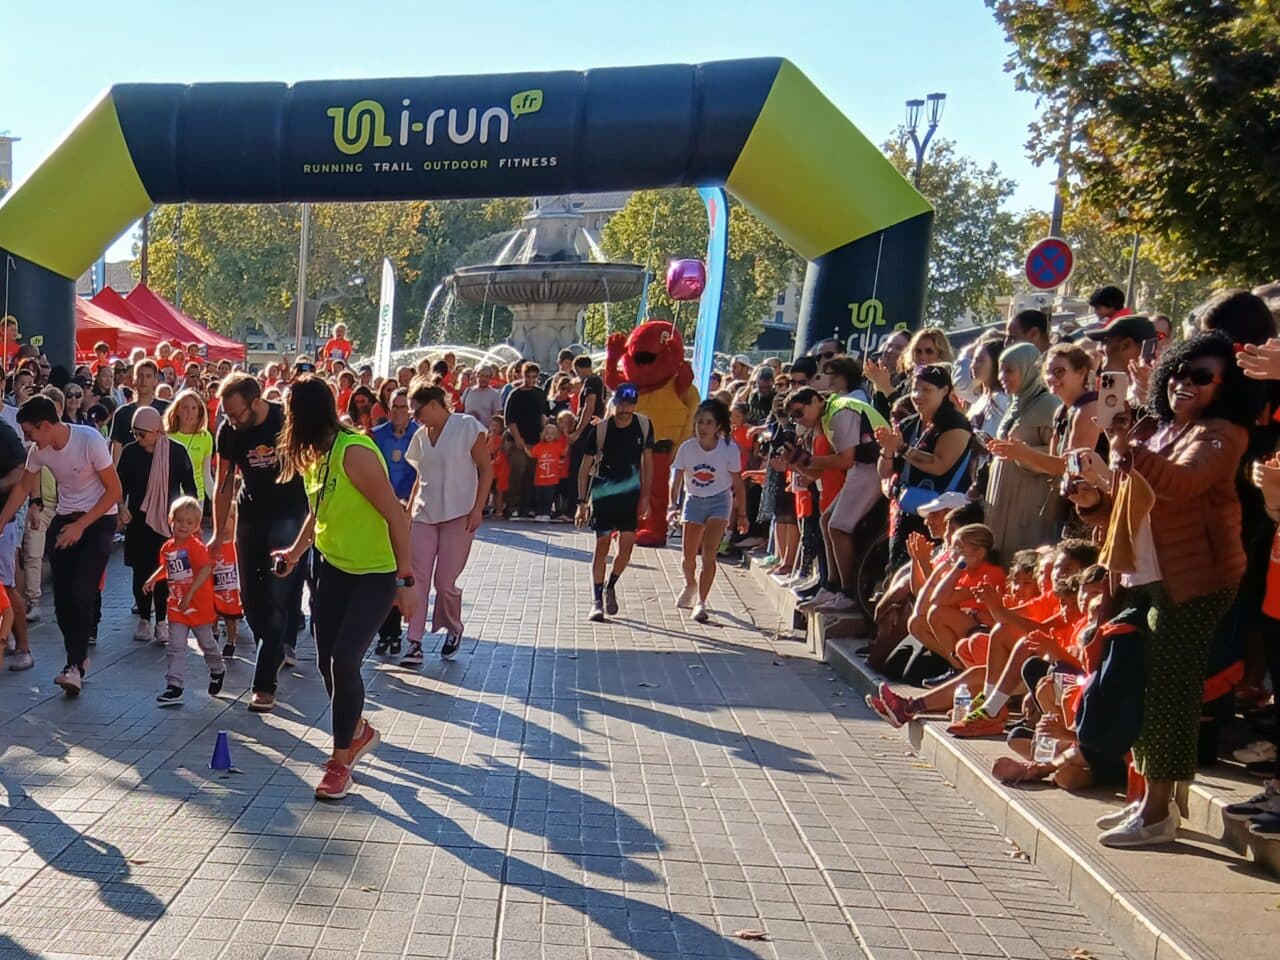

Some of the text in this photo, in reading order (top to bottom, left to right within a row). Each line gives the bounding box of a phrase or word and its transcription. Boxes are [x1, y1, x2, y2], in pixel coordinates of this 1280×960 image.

[399, 98, 509, 146] i-run
[303, 156, 558, 174] RUNNING TRAIL OUTDOOR FITNESS
